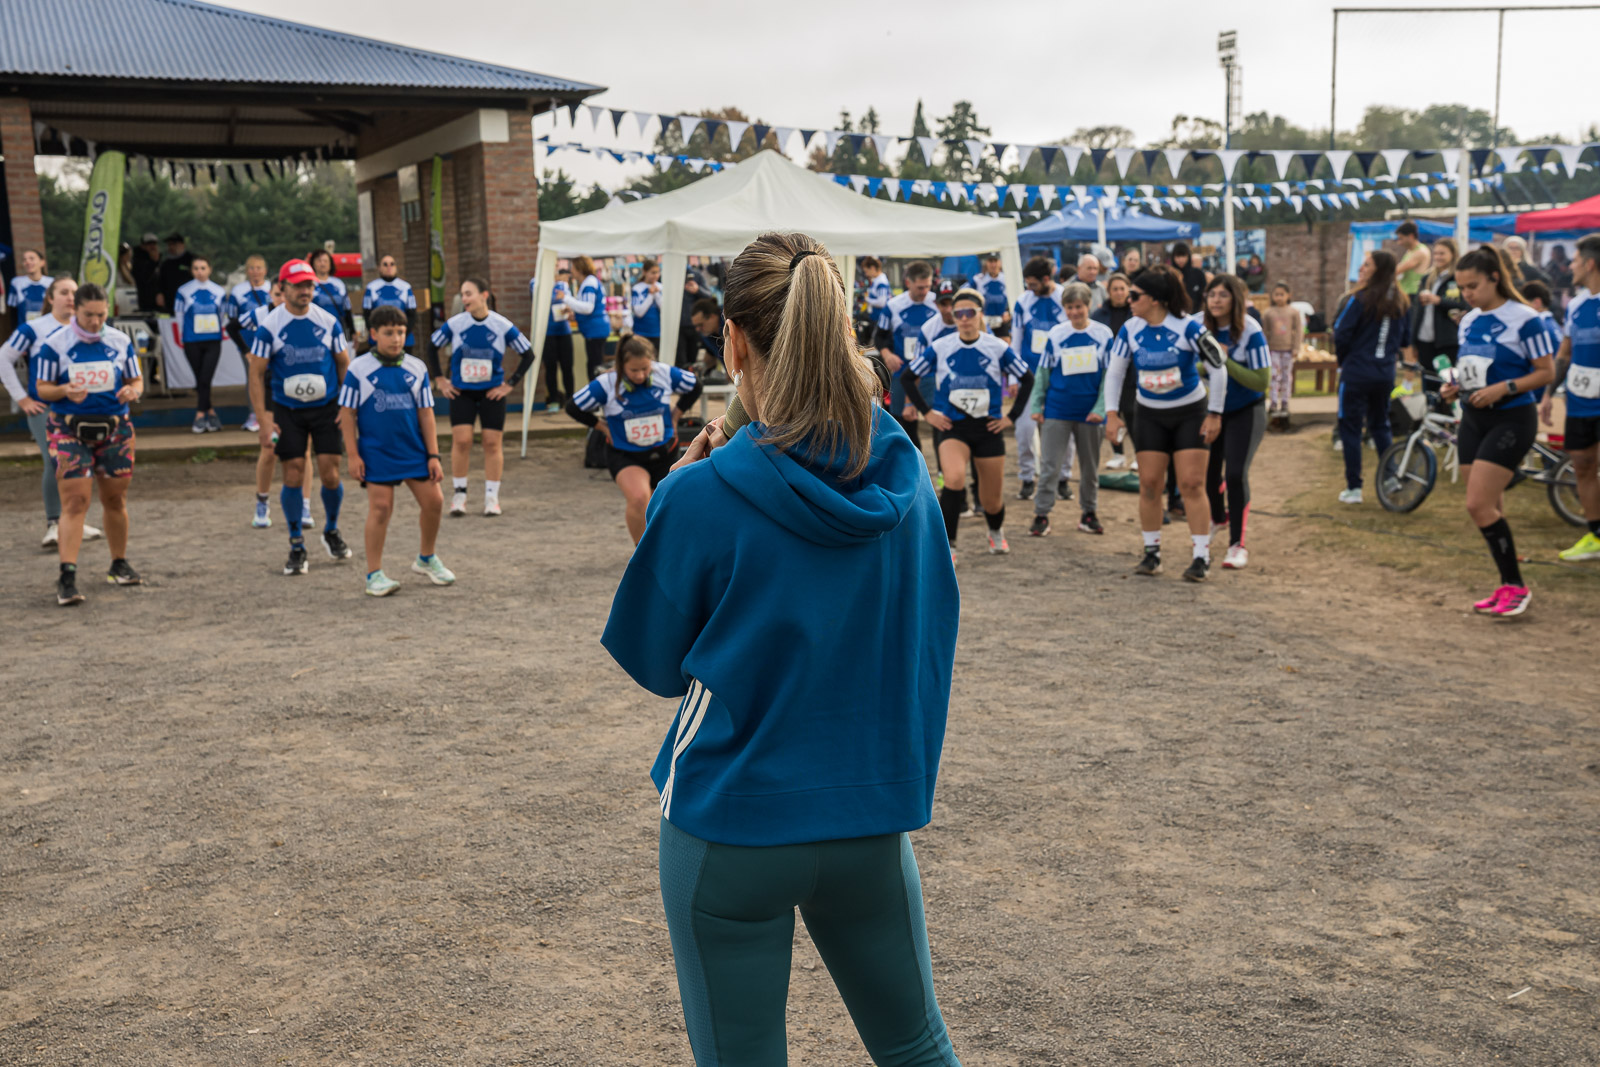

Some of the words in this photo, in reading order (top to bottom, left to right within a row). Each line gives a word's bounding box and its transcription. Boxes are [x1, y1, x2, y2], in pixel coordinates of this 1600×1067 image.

[1067, 353, 1092, 369] 737
[75, 370, 109, 385] 529
[464, 364, 488, 377] 518
[1144, 372, 1176, 389] 515
[1573, 375, 1590, 389] 69
[295, 382, 316, 396] 66
[960, 398, 978, 411] 37
[631, 423, 660, 440] 521
